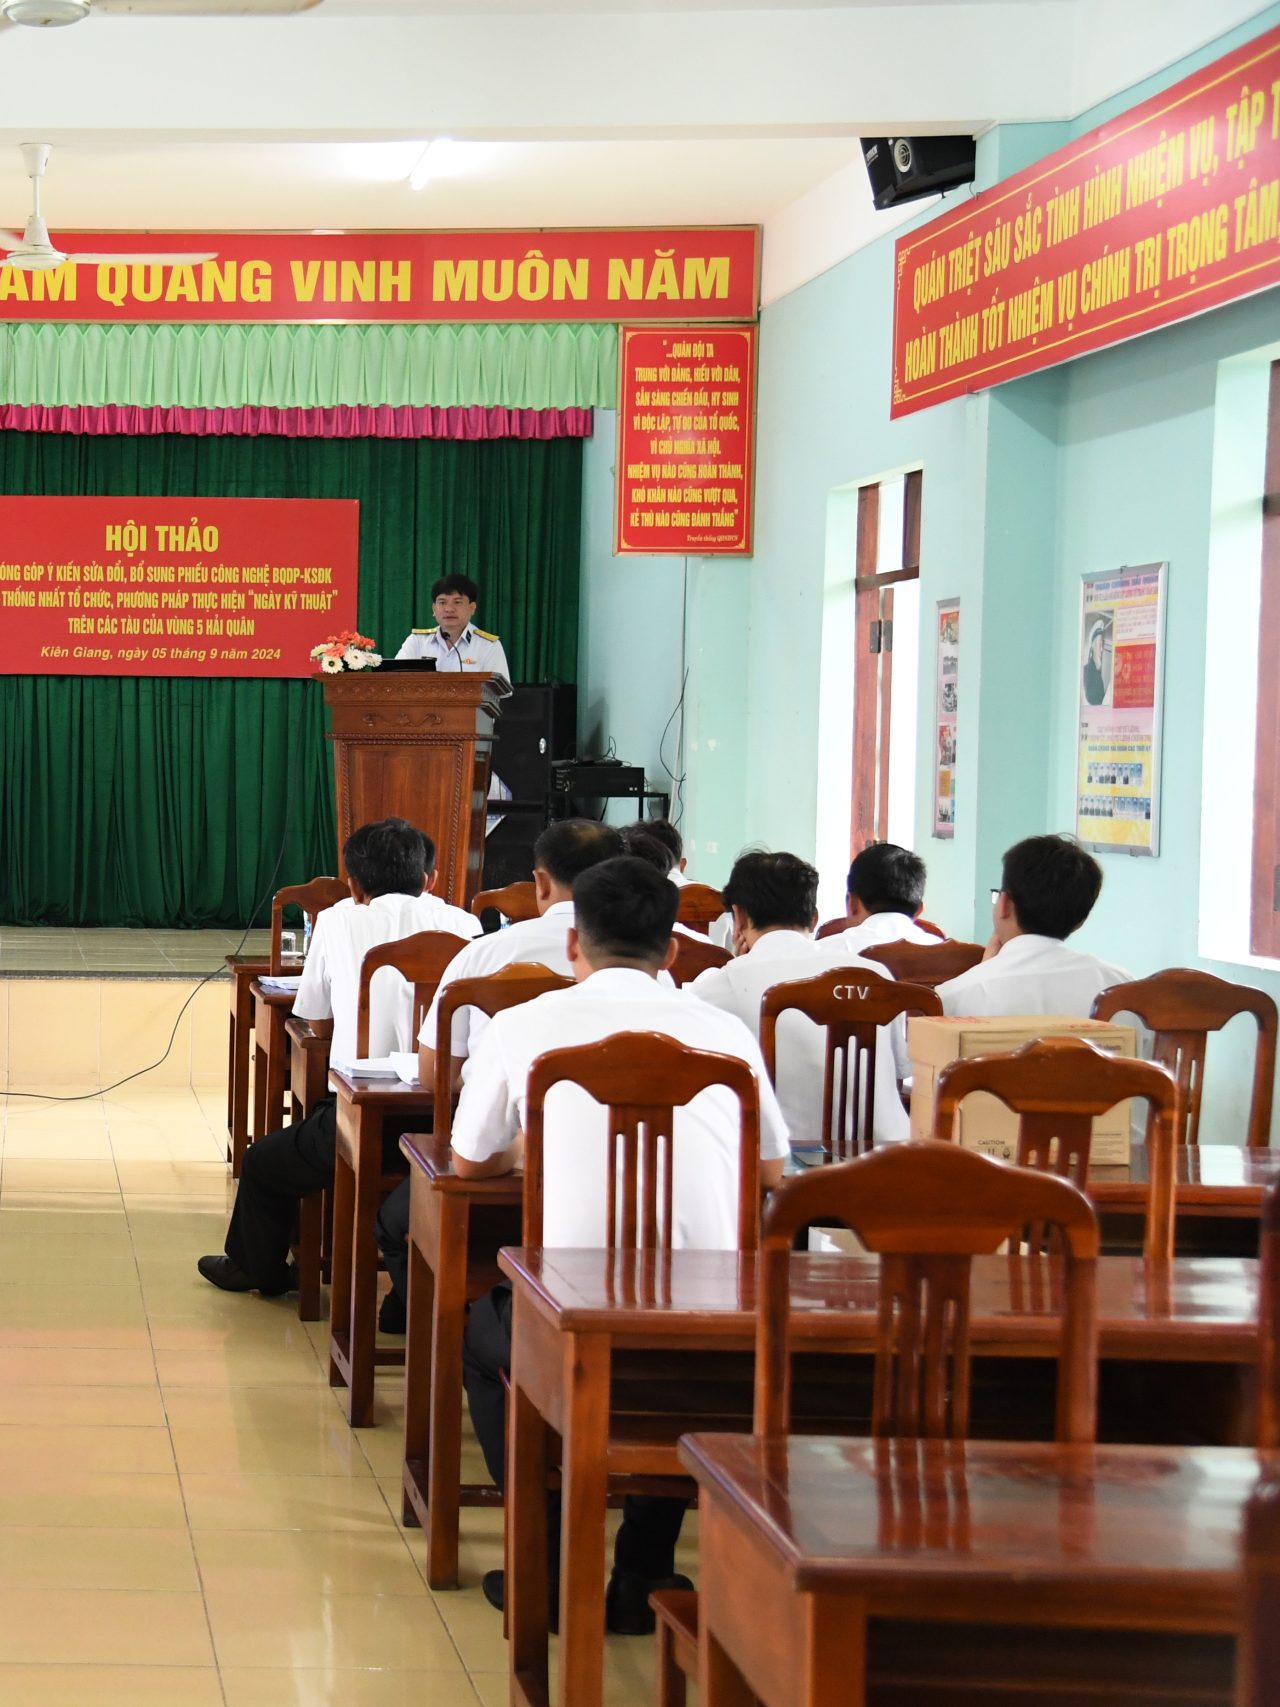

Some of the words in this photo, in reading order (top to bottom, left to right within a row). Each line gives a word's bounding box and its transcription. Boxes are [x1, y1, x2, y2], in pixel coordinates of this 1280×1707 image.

[913, 251, 946, 314] QUÁN
[948, 231, 982, 296] TRIỆT
[983, 217, 1011, 278] SÂU
[1013, 192, 1042, 264] SẮC
[1046, 185, 1080, 248] TÌNH
[1083, 163, 1122, 231] HÌNH
[1126, 130, 1185, 211] NHIỆM
[1190, 115, 1219, 187] VỤ,
[1226, 85, 1266, 170] TẬP
[96, 260, 272, 306] QUANG
[291, 260, 411, 302] VINH
[432, 250, 589, 301] MUÔN
[606, 248, 730, 300] NĂM
[905, 326, 937, 384] HOÀN
[939, 311, 979, 370] THÀNH
[982, 287, 1005, 353] TỐT
[1007, 276, 1054, 345] NHIỆM
[1057, 269, 1078, 331] VỤ
[1080, 245, 1131, 313] CHÍNH
[1135, 233, 1162, 299] TRỊ
[1167, 203, 1229, 285] TRỌNG
[105, 520, 147, 557] HỘI
[154, 517, 219, 552] THẢO
[23, 561, 44, 581] GÓP
[47, 561, 54, 581] Ý
[56, 560, 80, 581] KIẾN
[83, 560, 104, 582] SỬA
[130, 560, 144, 582] BỔ
[146, 565, 175, 582] SUNG
[178, 562, 208, 583] PHIẾU
[211, 563, 239, 583] CÔNG
[242, 564, 269, 587] NGHỆ
[2, 585, 35, 607] THỐNG
[38, 586, 65, 607] NHẤT
[68, 585, 81, 607] TỔ
[83, 588, 114, 609] CHỨC,
[117, 590, 158, 608] PHƯƠNG
[161, 590, 189, 609] PHÁP
[192, 591, 218, 613] THỰC
[221, 589, 245, 613] HIỆN
[284, 590, 297, 610] KỸ
[68, 614, 94, 634] TRÊN
[97, 614, 117, 634] CÁC
[121, 614, 140, 634] TÀU
[143, 613, 163, 635] CỦA
[166, 616, 194, 635] VÙNG
[196, 619, 203, 635] 5
[206, 614, 223, 635] HẢI
[226, 616, 255, 637] QUÂN
[40, 646, 69, 658] Kiên
[73, 646, 113, 661] Giang,
[117, 647, 148, 661] ngày
[151, 647, 167, 659] 05
[170, 648, 206, 662] tháng
[209, 648, 217, 659] 9
[220, 648, 247, 659] năm
[251, 648, 281, 660] 2024
[833, 984, 869, 1000] CTV
